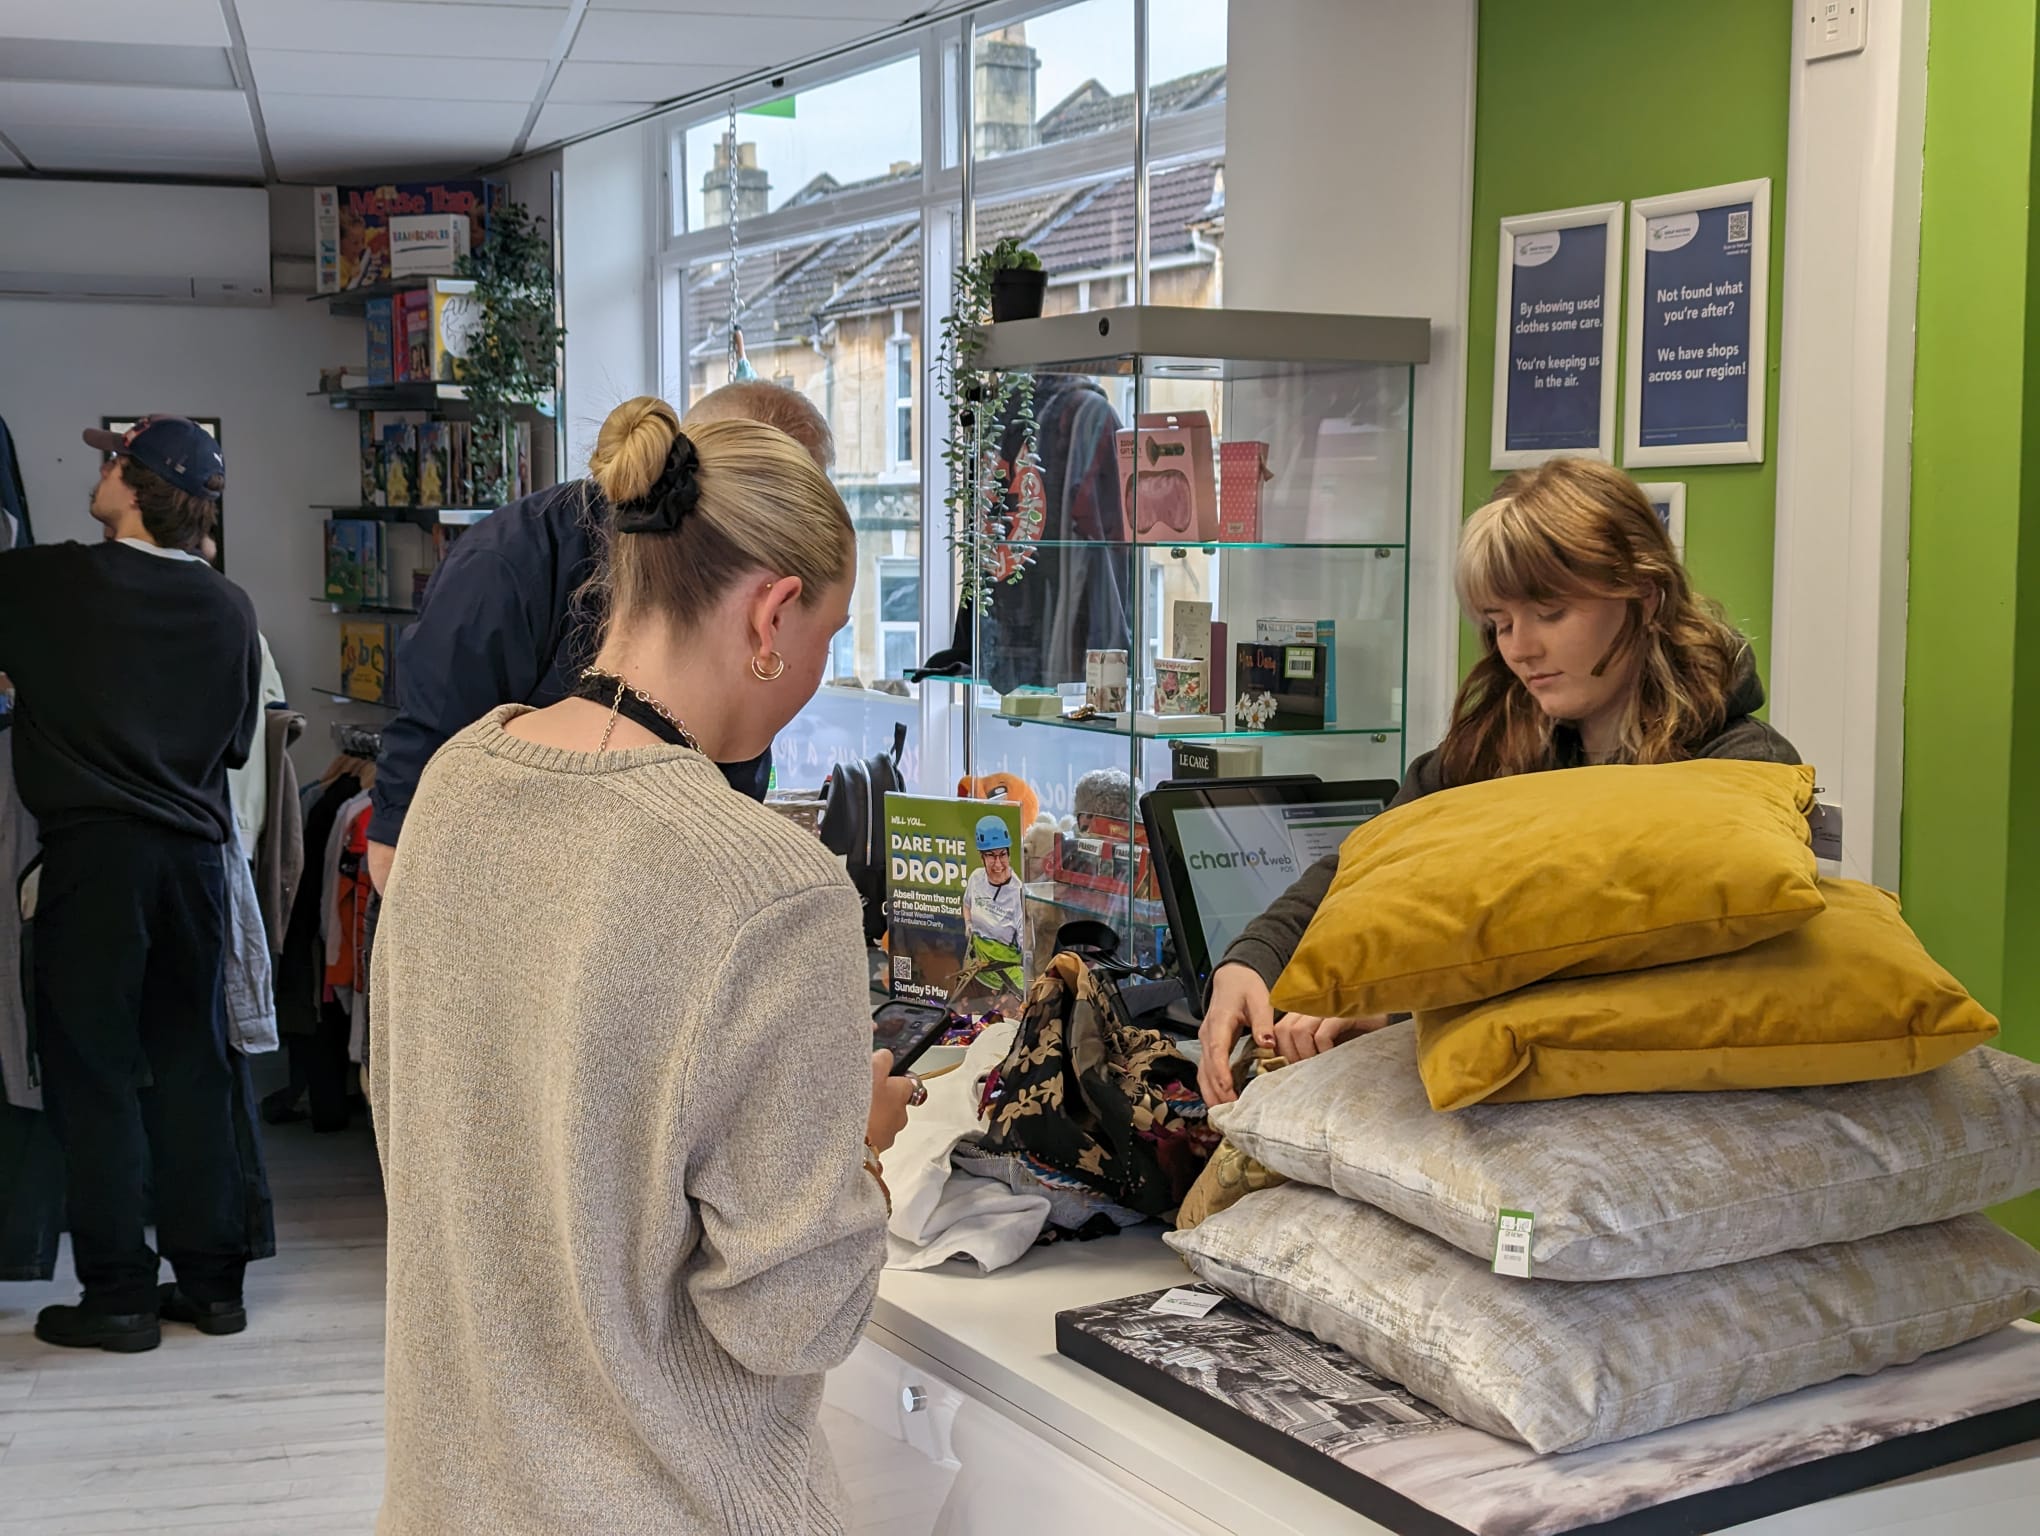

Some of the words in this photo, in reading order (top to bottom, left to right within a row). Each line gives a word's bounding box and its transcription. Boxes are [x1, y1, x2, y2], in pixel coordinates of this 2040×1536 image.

[349, 188, 425, 216] Mouse
[426, 185, 475, 214] Trap
[1657, 289, 1678, 303] Not
[1681, 283, 1713, 300] found
[1715, 281, 1744, 296] what
[1520, 302, 1533, 318] By
[1535, 299, 1575, 315] showing
[1577, 295, 1600, 310] used
[1664, 306, 1699, 326] you're
[1701, 301, 1735, 318] after?
[1516, 319, 1550, 333] clothes
[1552, 320, 1578, 332] some
[1580, 318, 1603, 329] care.
[1657, 346, 1676, 362] We
[1678, 346, 1705, 360] have
[1707, 342, 1740, 360] shops
[1516, 357, 1546, 371] You're
[1548, 354, 1587, 372] keeping
[1589, 355, 1600, 366] us
[1648, 369, 1682, 383] across
[1684, 368, 1704, 380] our
[1706, 361, 1747, 381] region!
[1534, 375, 1544, 388] in
[1546, 373, 1562, 387] the
[1564, 373, 1580, 387] air.
[1179, 753, 1188, 767] LE
[1189, 755, 1210, 770] CARRÉ
[891, 815, 906, 825] WILL
[891, 833, 933, 853] DARE
[935, 837, 967, 856] THE
[1189, 847, 1269, 871] chariot
[1269, 854, 1292, 865] web
[892, 856, 968, 888] DROP!
[893, 889, 914, 900] Abseil
[916, 891, 932, 902] from
[934, 893, 944, 903] the
[945, 895, 960, 905] roof
[893, 900, 900, 909] of
[902, 901, 913, 910] the
[914, 901, 940, 913] Dolman
[941, 904, 962, 916] Stand
[901, 917, 926, 926] Ambulance
[927, 919, 944, 930] Charity
[894, 980, 924, 997] Sunday
[925, 985, 931, 996] 5
[931, 986, 949, 1000] May
